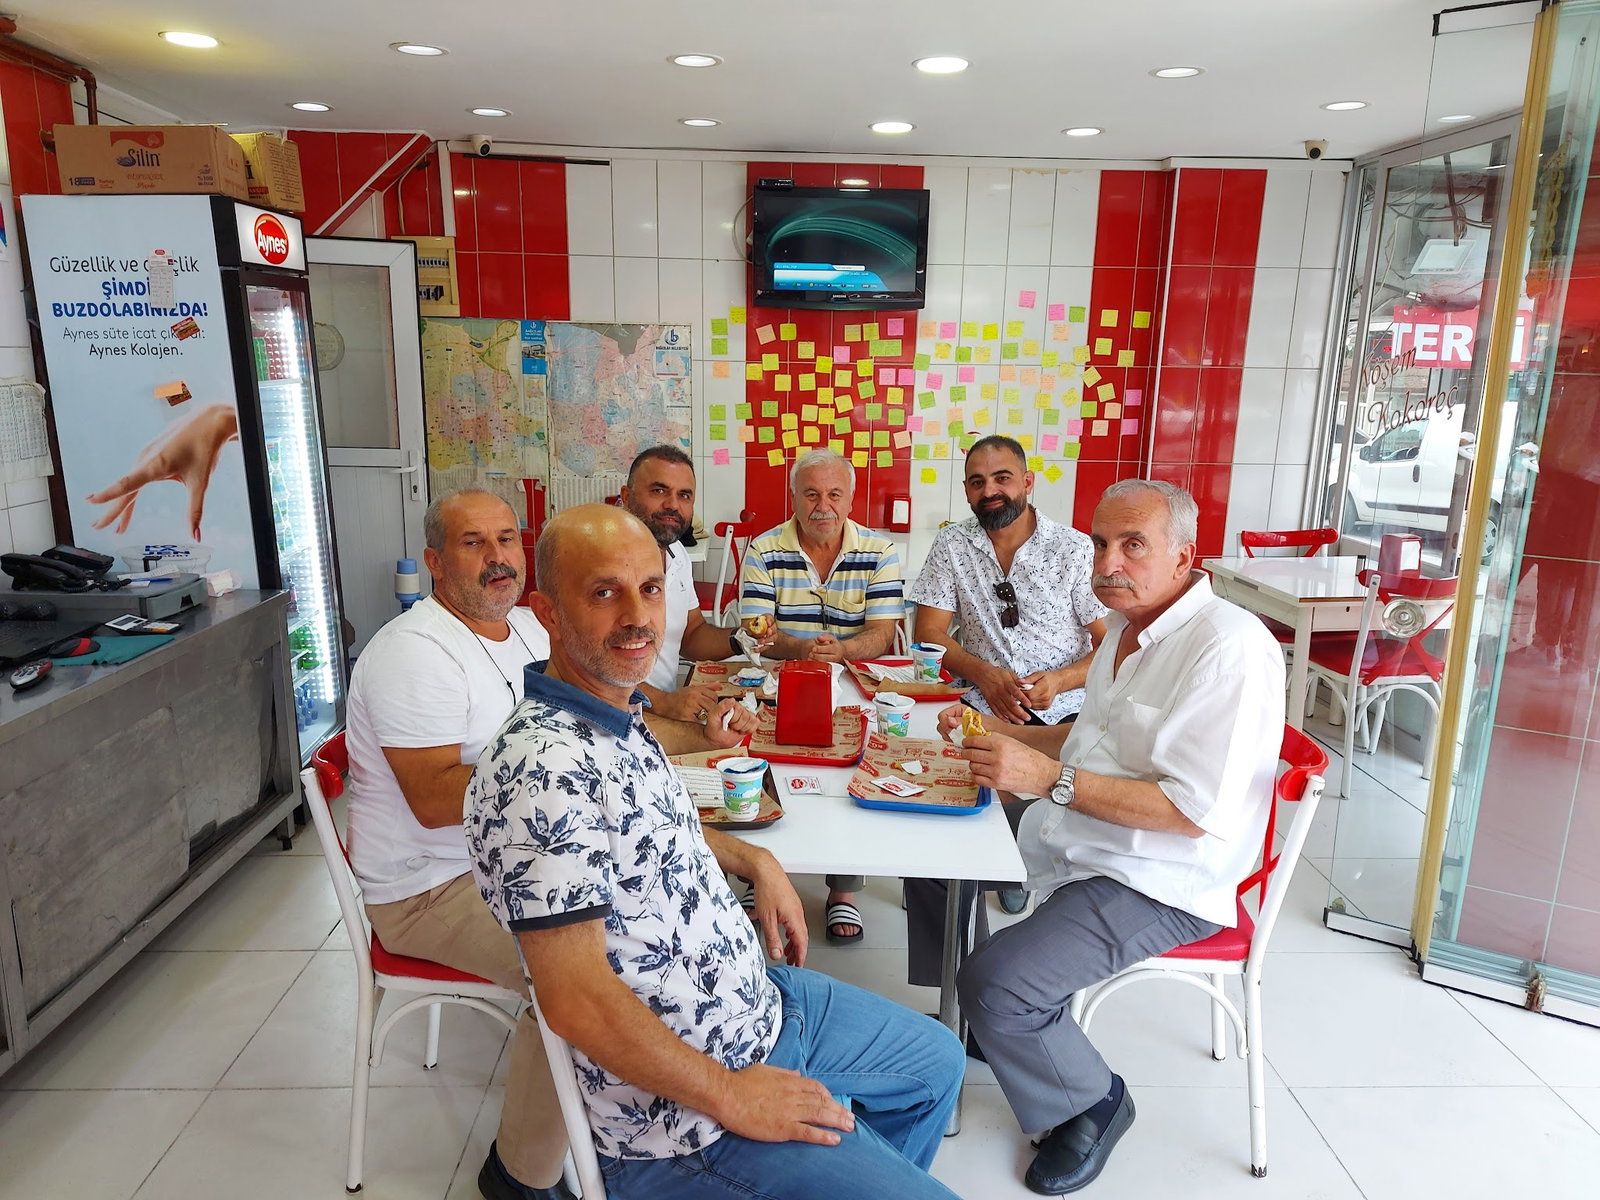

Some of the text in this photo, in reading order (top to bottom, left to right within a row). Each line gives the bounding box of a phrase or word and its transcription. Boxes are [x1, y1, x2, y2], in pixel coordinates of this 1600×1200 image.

[124, 148, 161, 167] Silin
[257, 228, 288, 256] Aynes
[49, 256, 117, 273] Güzellik
[119, 259, 139, 273] ve
[63, 327, 100, 343] Aynes
[103, 327, 129, 339] süte
[132, 327, 157, 339] icat
[1390, 316, 1525, 363] TERİ
[89, 343, 184, 359] Aynes Kolajen.
[1367, 386, 1458, 441] Kokoreç
